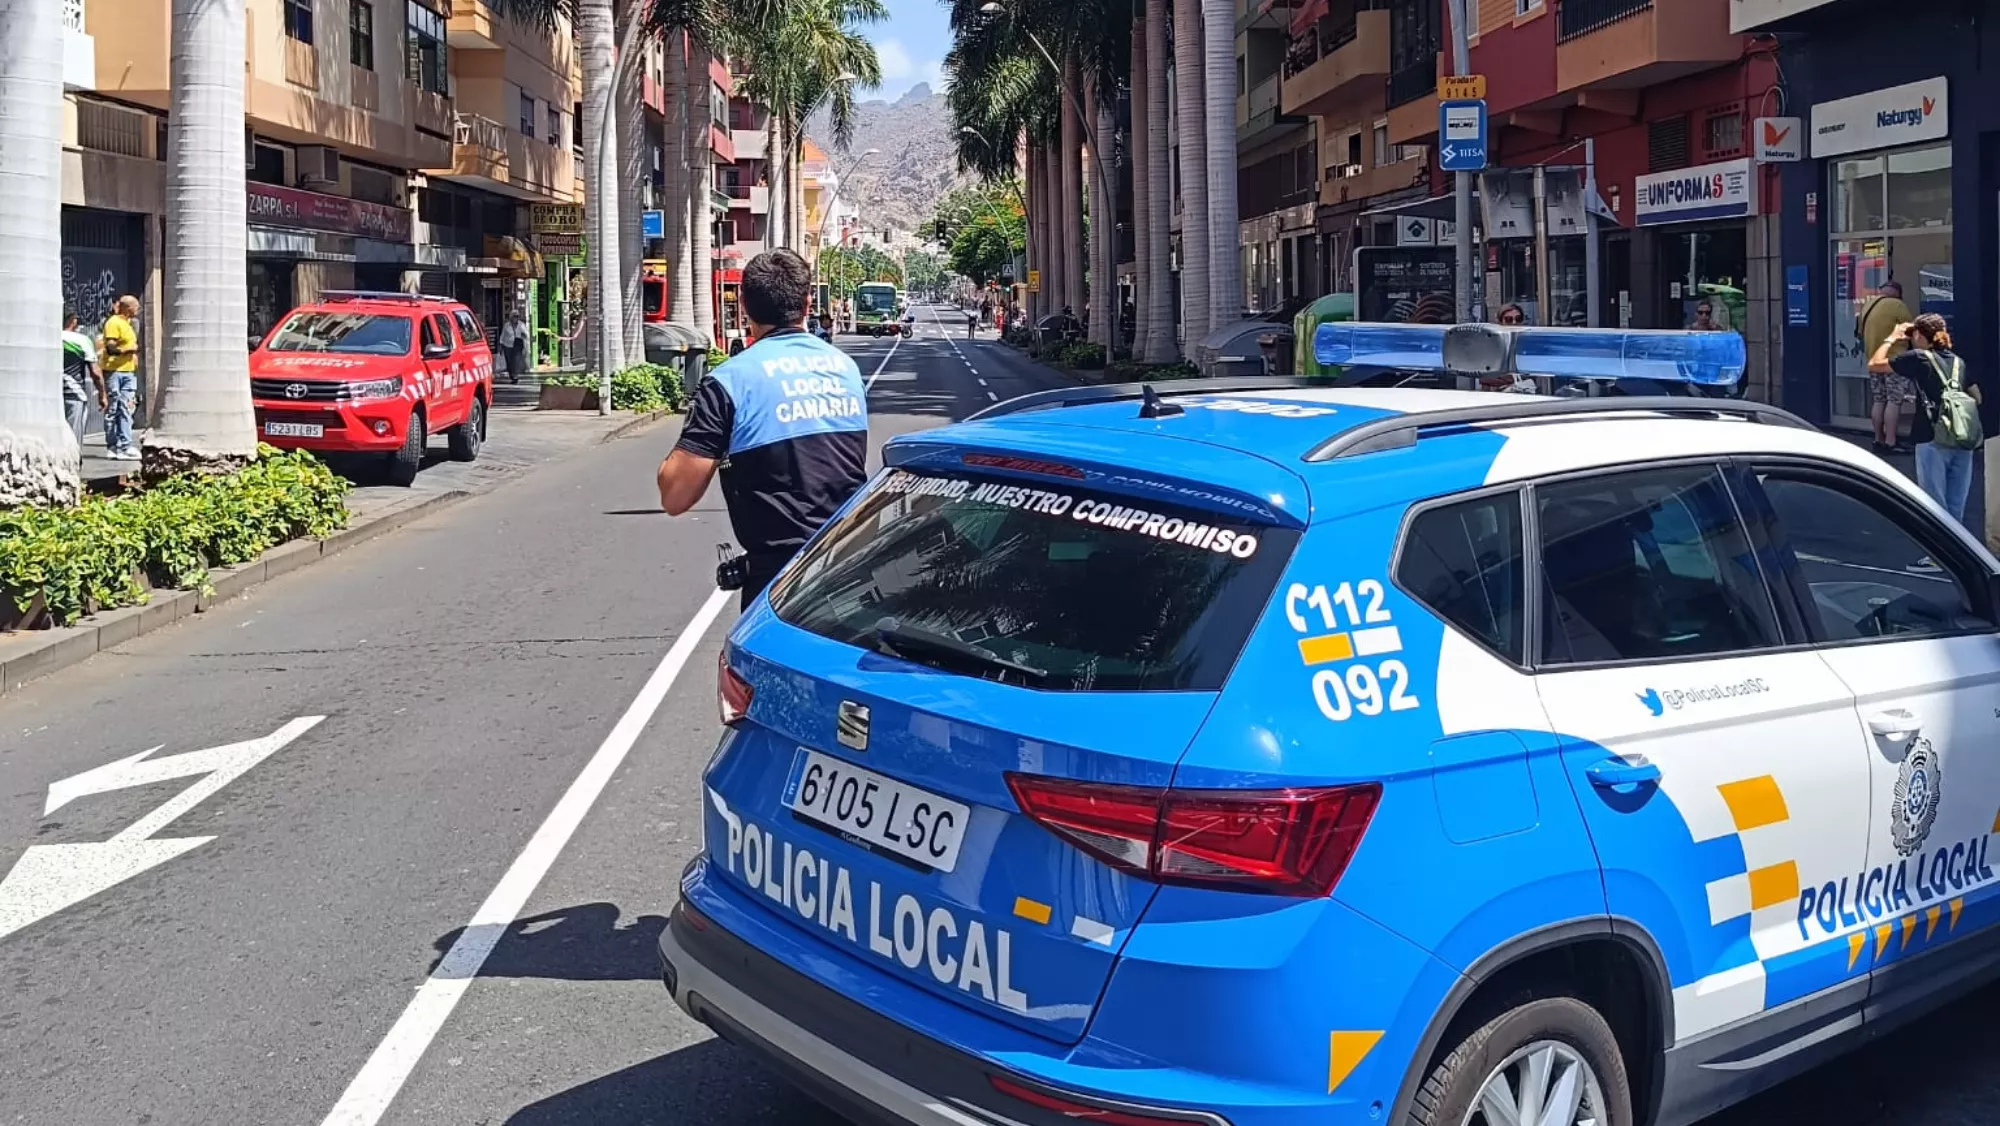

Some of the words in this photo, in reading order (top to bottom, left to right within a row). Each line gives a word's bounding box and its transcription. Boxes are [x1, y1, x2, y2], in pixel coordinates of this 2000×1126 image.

[1877, 107, 1923, 128] Naturgy
[1459, 148, 1485, 157] TITSA
[1765, 150, 1795, 158] Naturgy
[1648, 173, 1723, 206] UNIFORMAS
[249, 193, 283, 217] ZARPA
[533, 205, 576, 215] COMPRA
[534, 215, 545, 224] DE
[549, 215, 577, 224] ORO
[762, 356, 849, 377] POLICIA
[781, 377, 848, 398] LOCAL
[776, 396, 861, 423] CANARIA
[883, 471, 969, 503] SEGURIDAD,
[970, 482, 1072, 516] NUESTRO
[1072, 501, 1258, 559] COMPROMISO
[1311, 659, 1420, 722] 092
[1662, 677, 1770, 710] @PoliciaLocalSC
[801, 763, 879, 829] 6105
[883, 792, 954, 858] LSC
[1798, 859, 1912, 941] POLICIA
[1917, 834, 1994, 901] LOCAL
[726, 810, 857, 942] POLICIA
[869, 881, 1027, 1013] LOCAL
